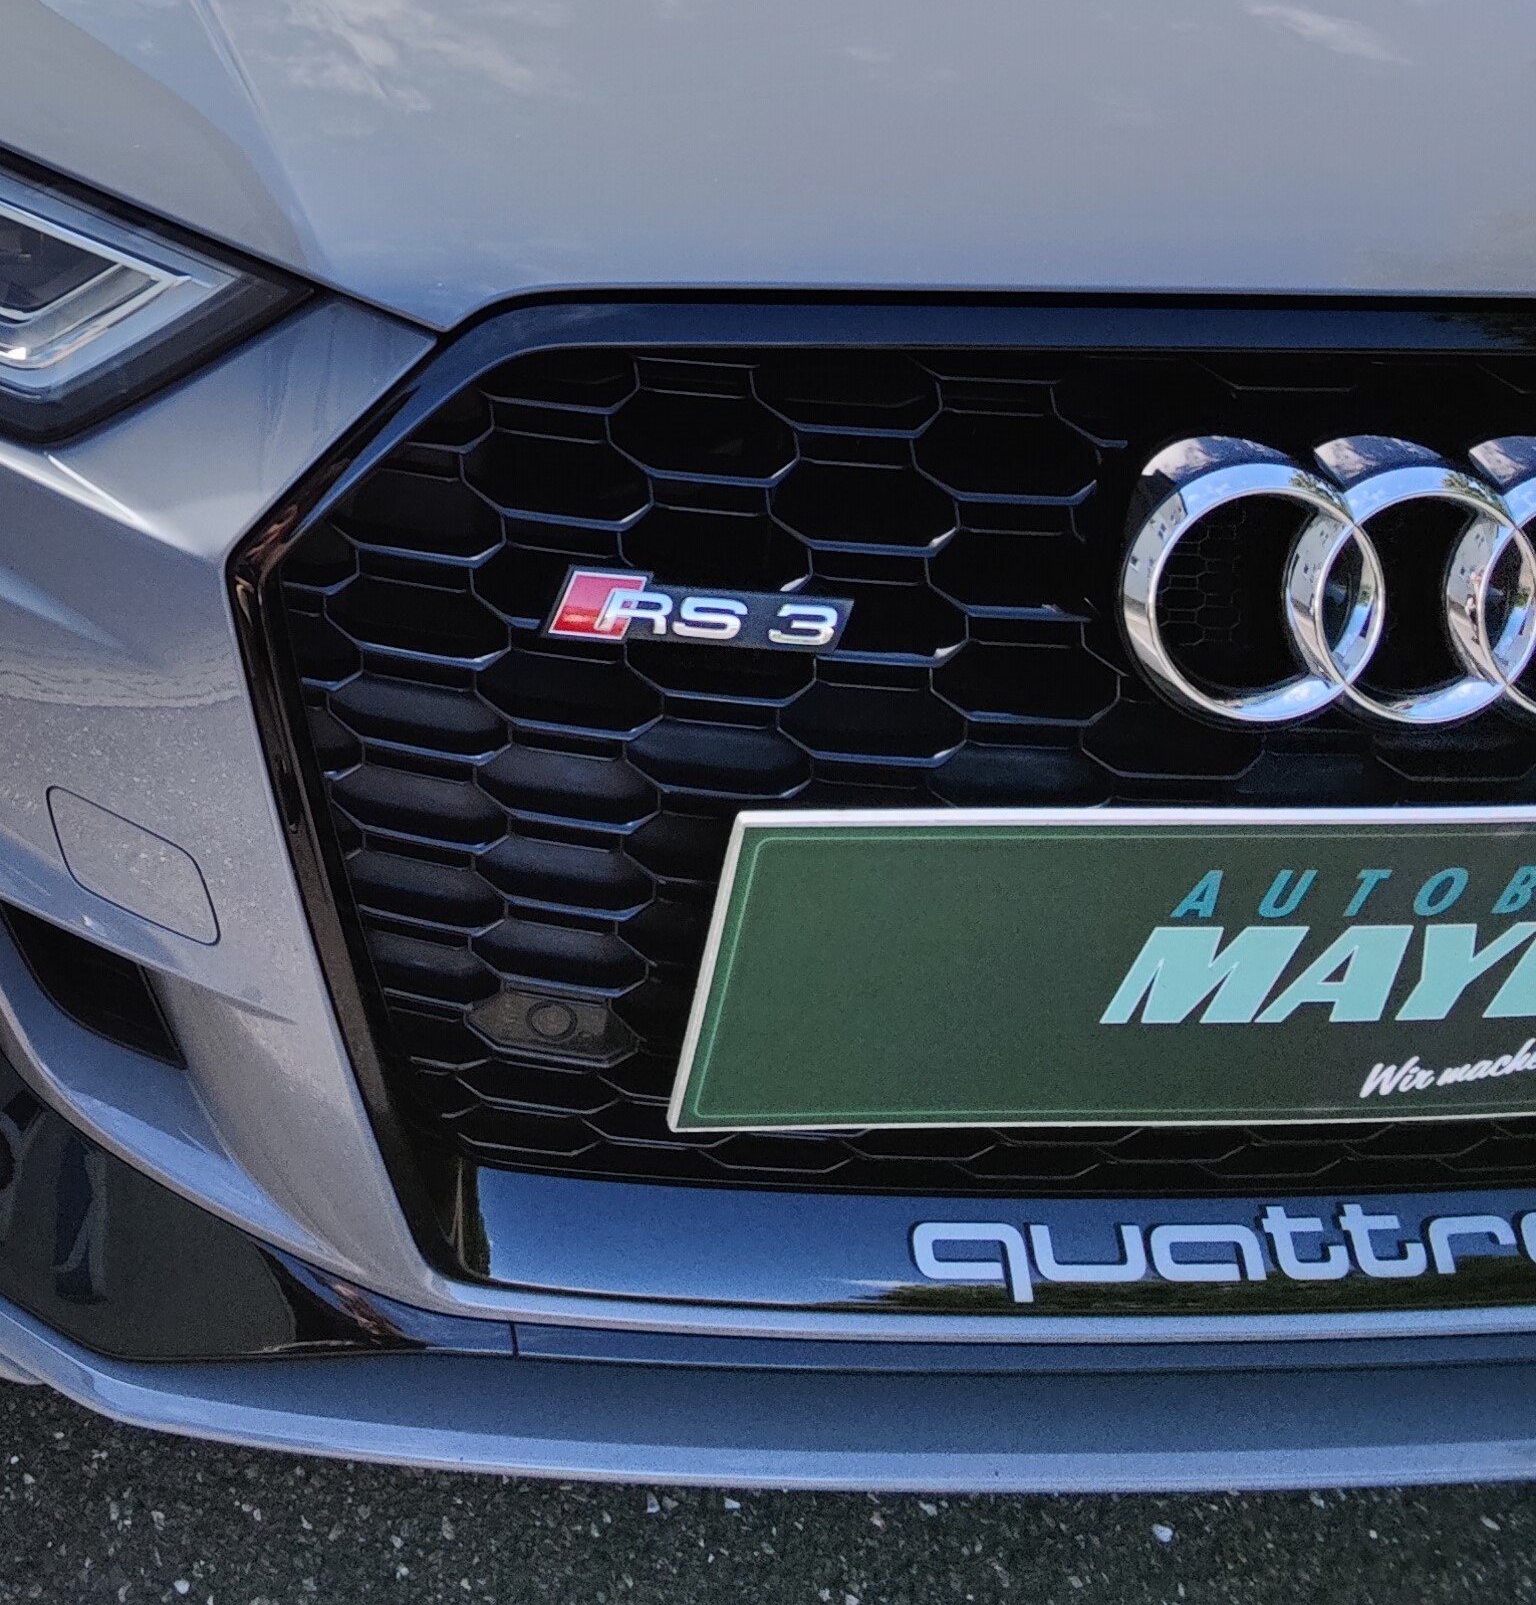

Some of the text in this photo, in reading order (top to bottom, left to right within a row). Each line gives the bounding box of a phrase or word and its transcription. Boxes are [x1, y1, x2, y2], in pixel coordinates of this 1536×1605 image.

[594, 588, 839, 646] RS 3
[1359, 1055, 1436, 1099] Wir
[911, 1204, 1536, 1304] quattr
